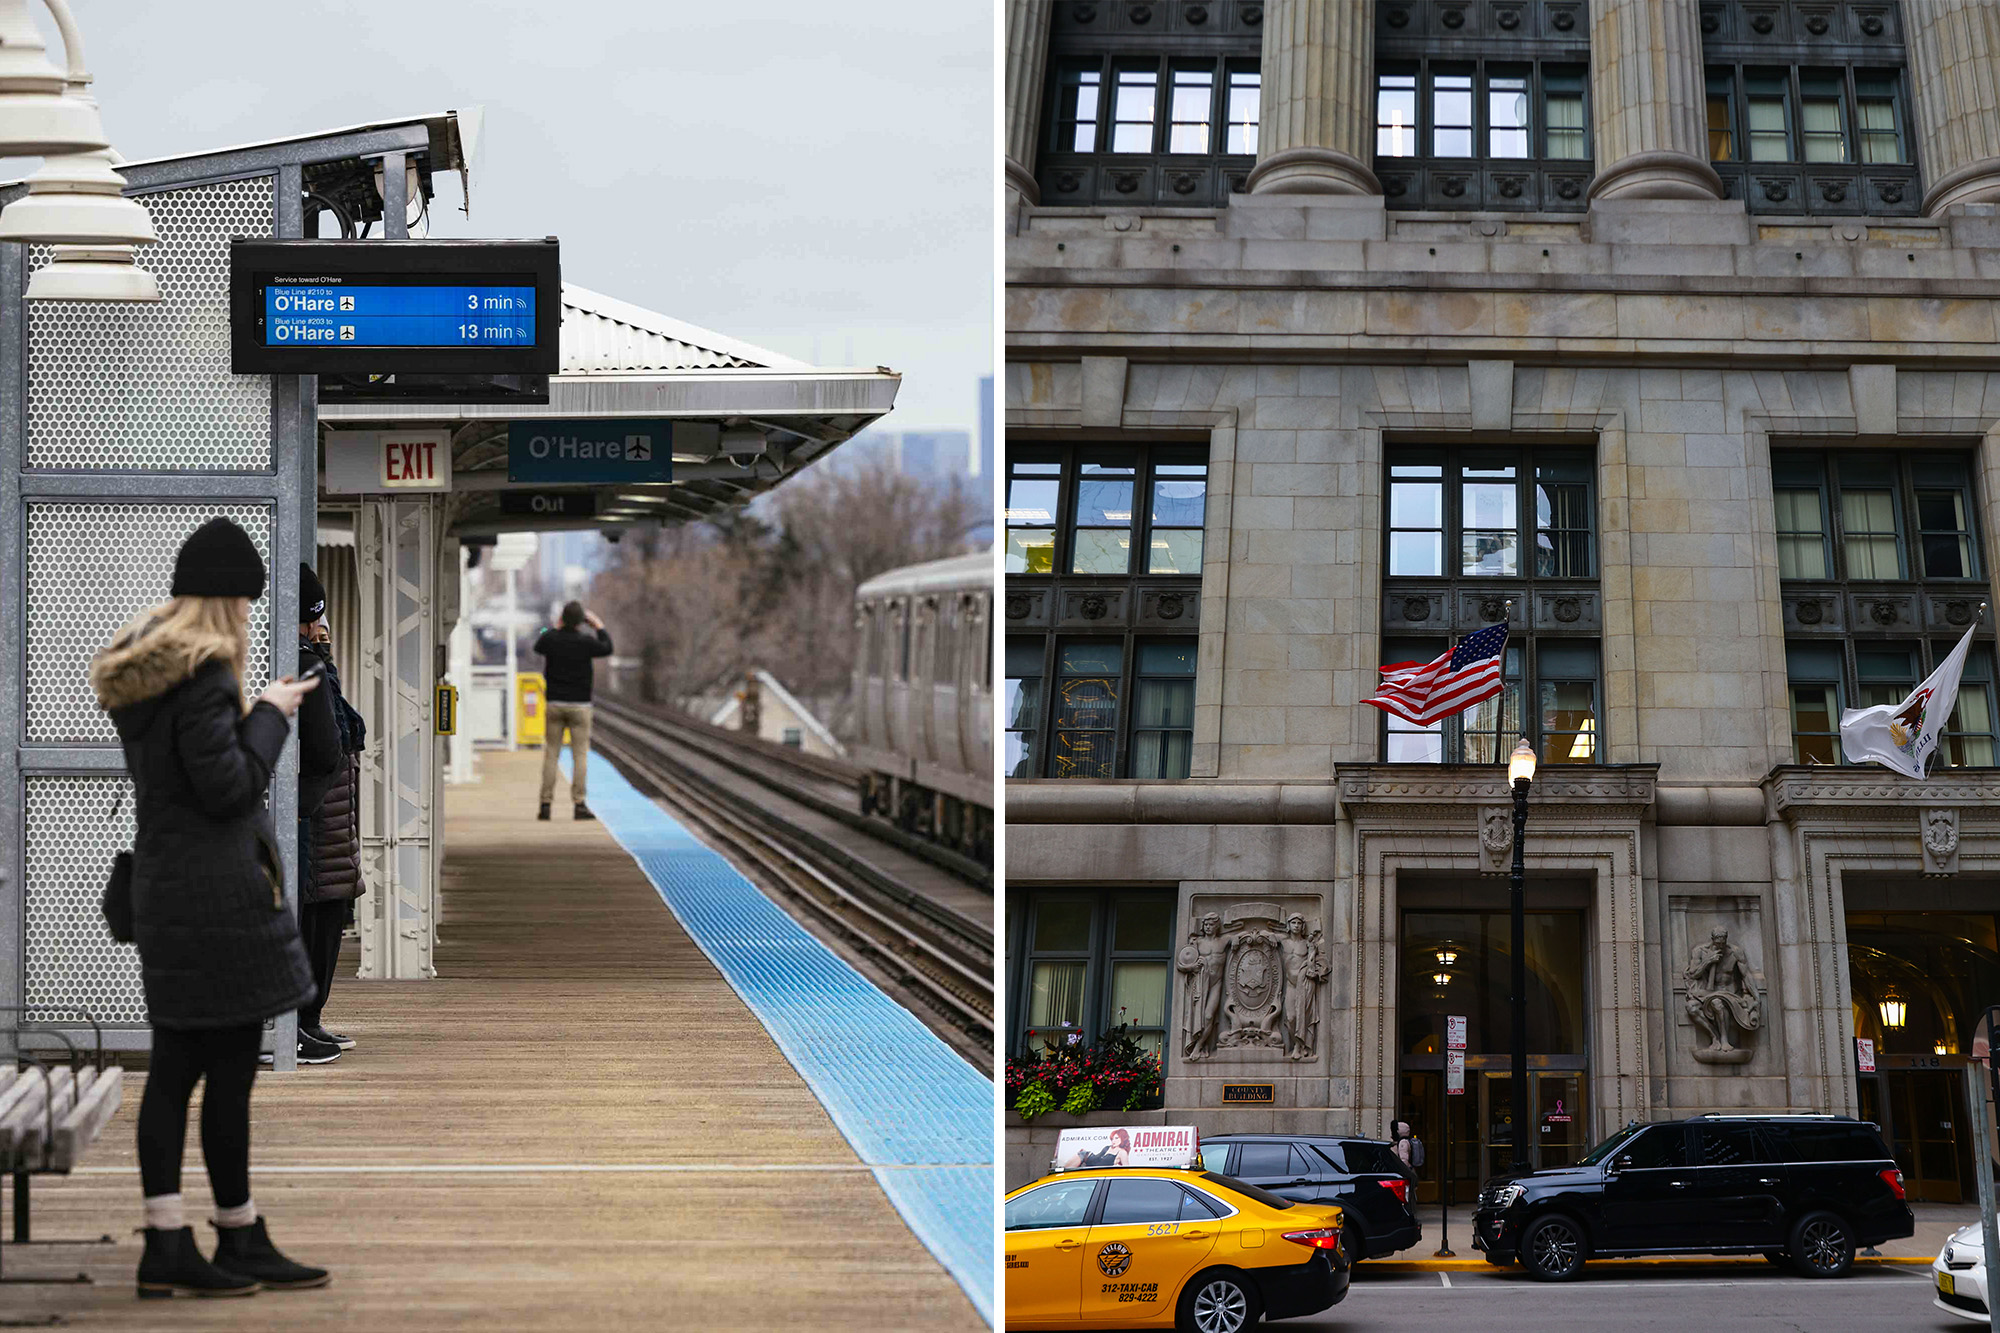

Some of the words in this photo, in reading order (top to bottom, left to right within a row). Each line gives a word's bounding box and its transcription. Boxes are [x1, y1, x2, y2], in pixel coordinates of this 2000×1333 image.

[275, 296, 335, 311] O'Hare
[468, 294, 478, 310] 3
[484, 294, 513, 309] min
[275, 325, 335, 340] O'Hare
[458, 324, 478, 339] 13
[484, 324, 513, 339] min
[529, 435, 621, 460] O'Hare
[386, 442, 436, 481] EXIT
[531, 494, 565, 513] Out
[1911, 1058, 1940, 1067] 118
[1133, 1131, 1190, 1147] ADMIRAL
[1147, 1223, 1180, 1237] 5627
[1102, 1243, 1128, 1255] YELLOW
[1106, 1267, 1123, 1275] CAB
[1101, 1283, 1159, 1293] 312-TAXI-CAB
[1118, 1293, 1158, 1302] 829-4222
